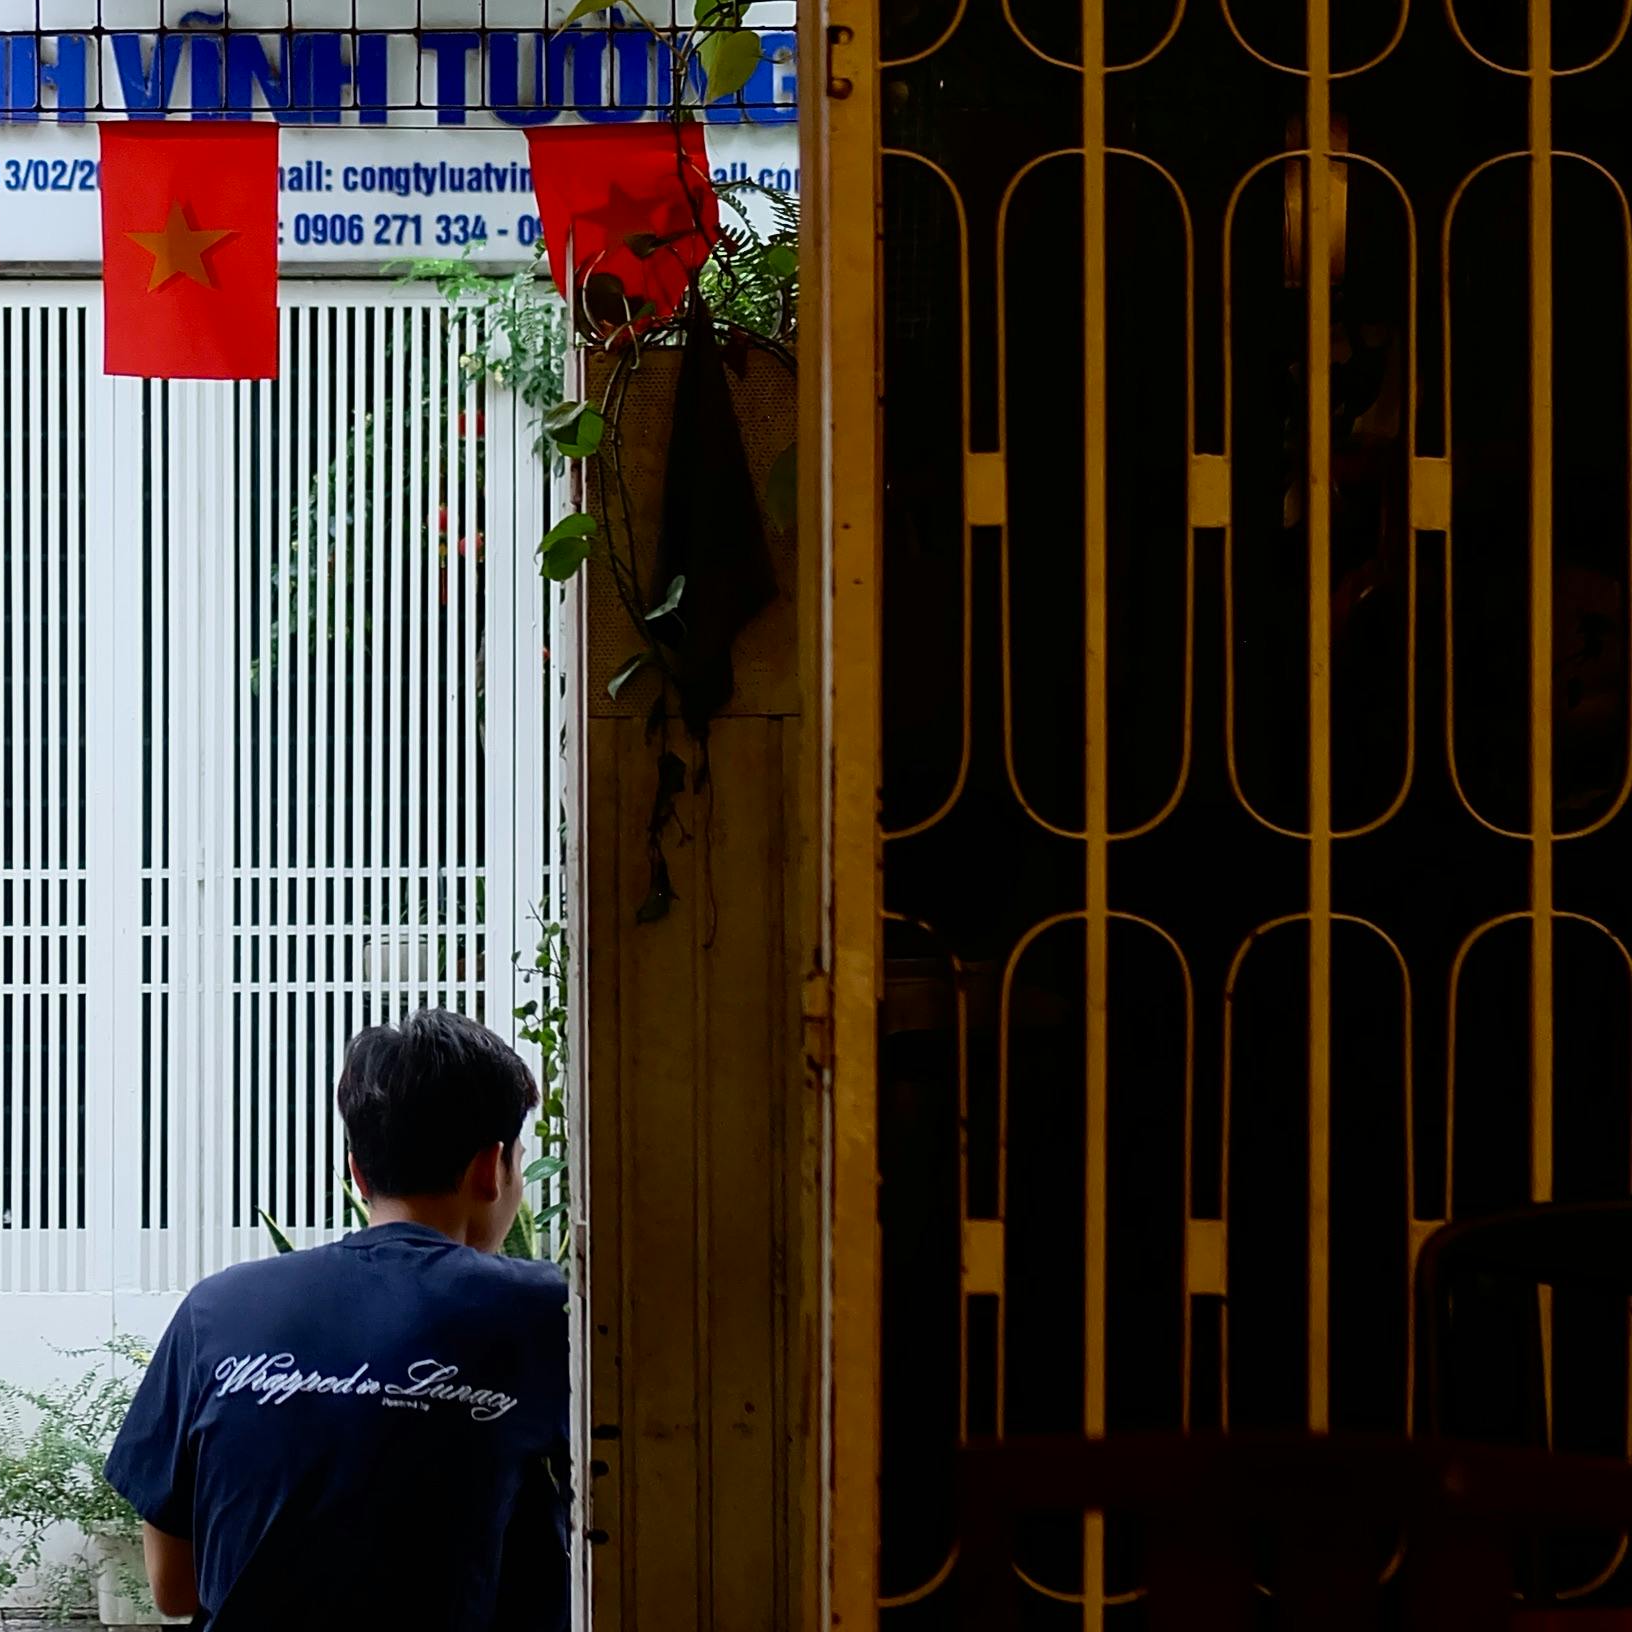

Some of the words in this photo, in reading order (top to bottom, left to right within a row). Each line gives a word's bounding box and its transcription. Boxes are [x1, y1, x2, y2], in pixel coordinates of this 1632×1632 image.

[111, 10, 388, 125] VĨNH
[294, 213, 365, 246] 0906
[374, 214, 423, 246] 271
[434, 214, 488, 247] 334
[214, 1352, 369, 1406] Wrapped
[384, 1358, 518, 1421] Lunacy
